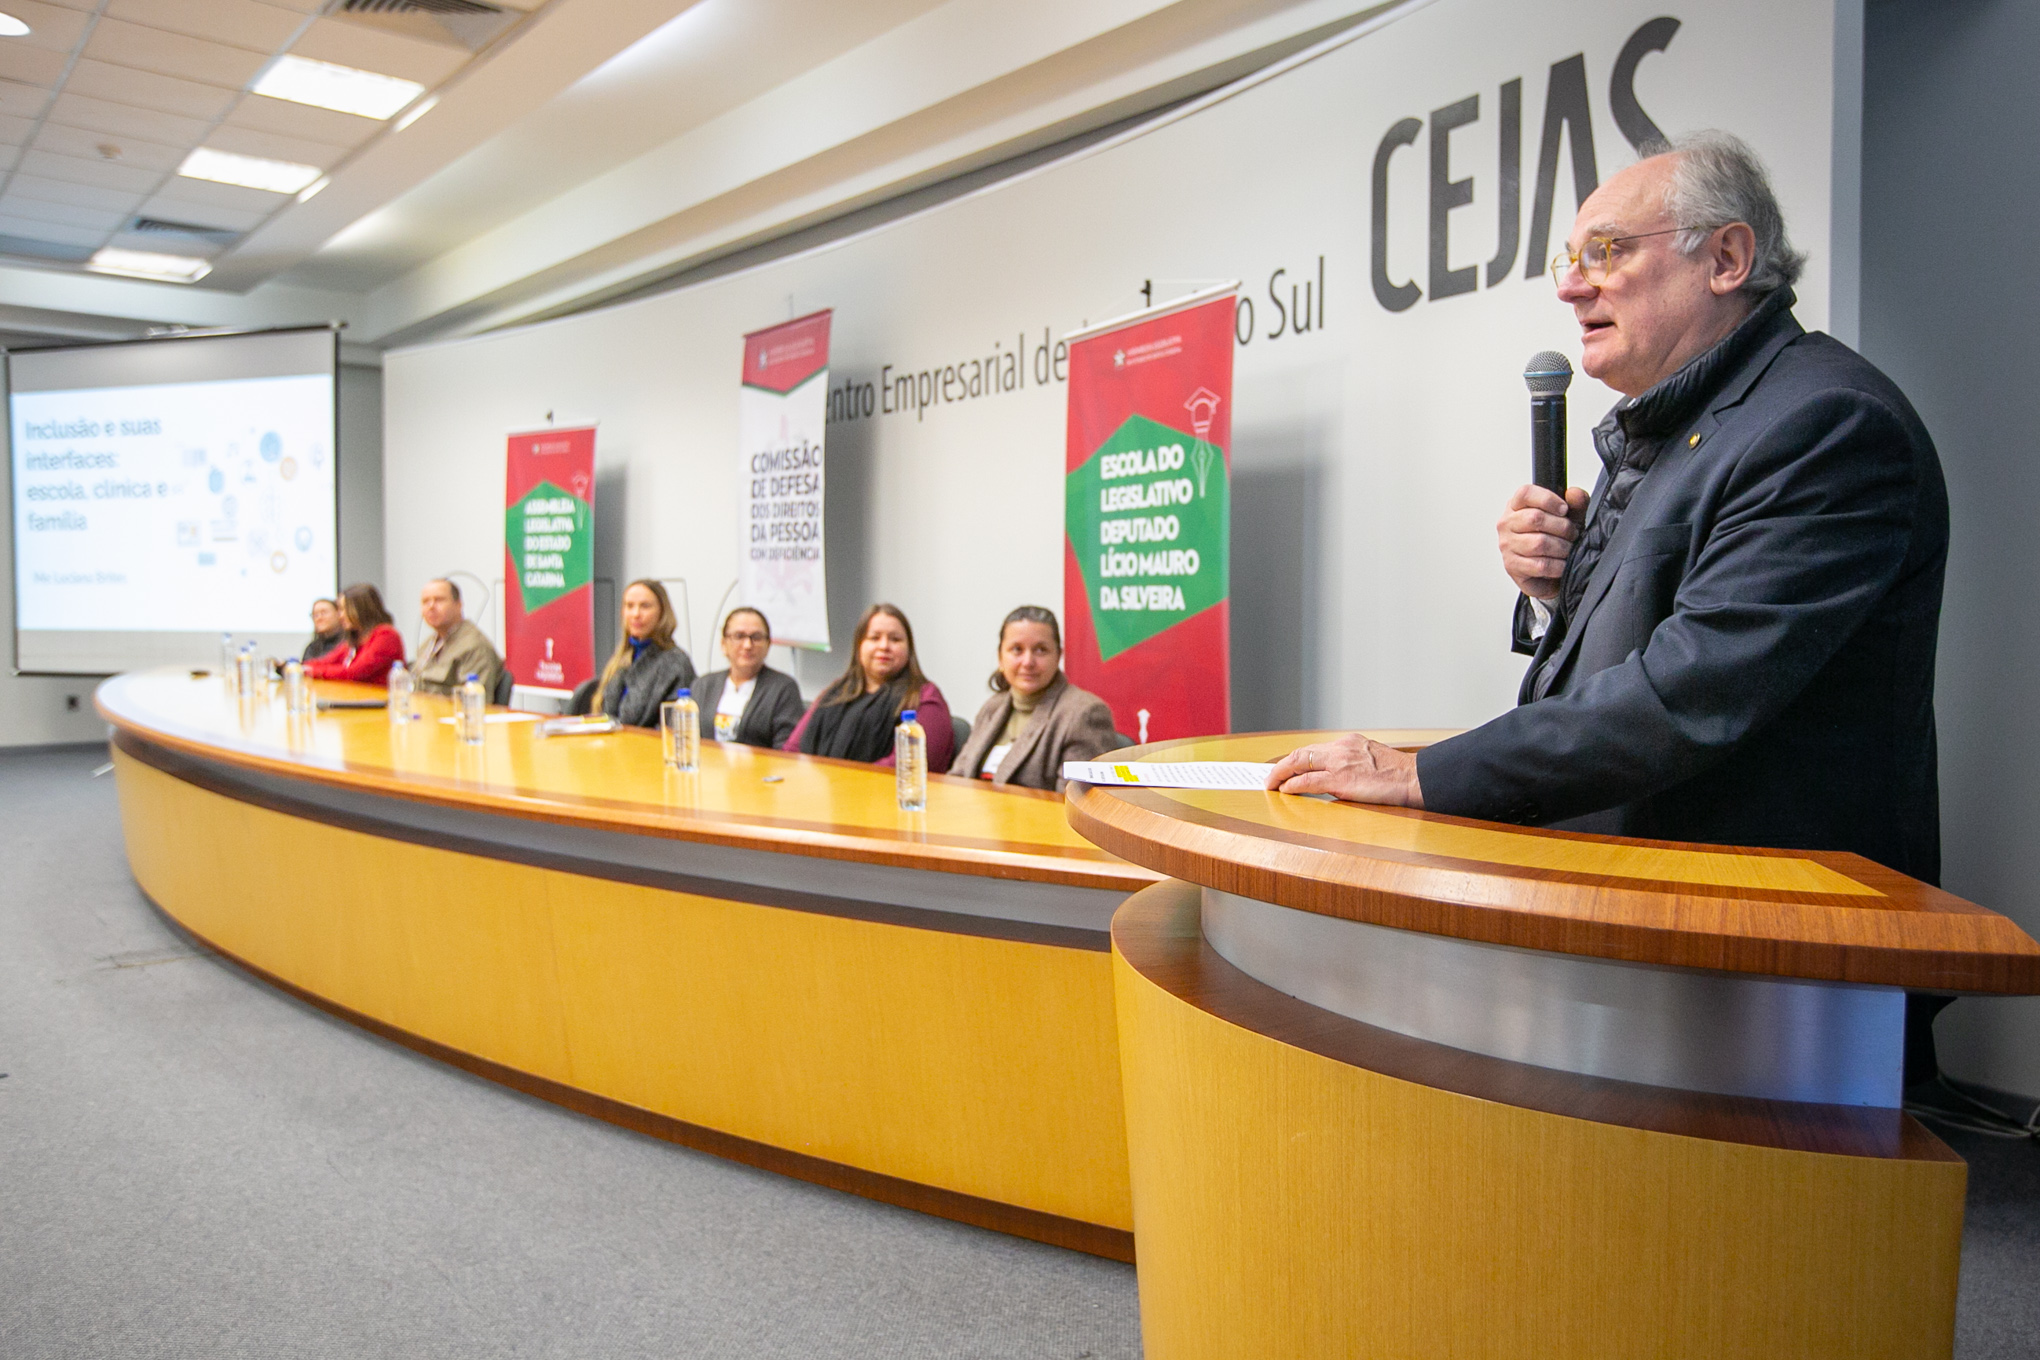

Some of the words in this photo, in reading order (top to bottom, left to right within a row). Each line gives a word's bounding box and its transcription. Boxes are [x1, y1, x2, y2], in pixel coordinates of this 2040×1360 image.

[1371, 16, 1682, 313] CEJAS
[881, 331, 1025, 422] Empresarial
[1035, 326, 1067, 386] de
[1268, 255, 1324, 340] Sul
[26, 418, 100, 440] Inclusão
[104, 421, 116, 436] e
[120, 419, 162, 436] suas
[751, 439, 822, 473] COMISSÃO
[1101, 449, 1158, 480] ESCOLA
[1158, 443, 1185, 472] DO
[156, 482, 168, 496] e
[752, 479, 766, 498] DE
[771, 473, 819, 497] DEFESA
[1101, 478, 1194, 512] LEGISLATIVO
[752, 503, 769, 519] DOS
[773, 501, 819, 518] DIREITOS
[752, 523, 767, 542] DA
[771, 521, 819, 541] PESSOA
[1100, 514, 1180, 545] DEPUTADO
[1101, 546, 1138, 577] LÍCIO
[1138, 549, 1200, 576] MAURO
[1100, 585, 1120, 610] DA
[1120, 584, 1186, 611] SILVEIRA
